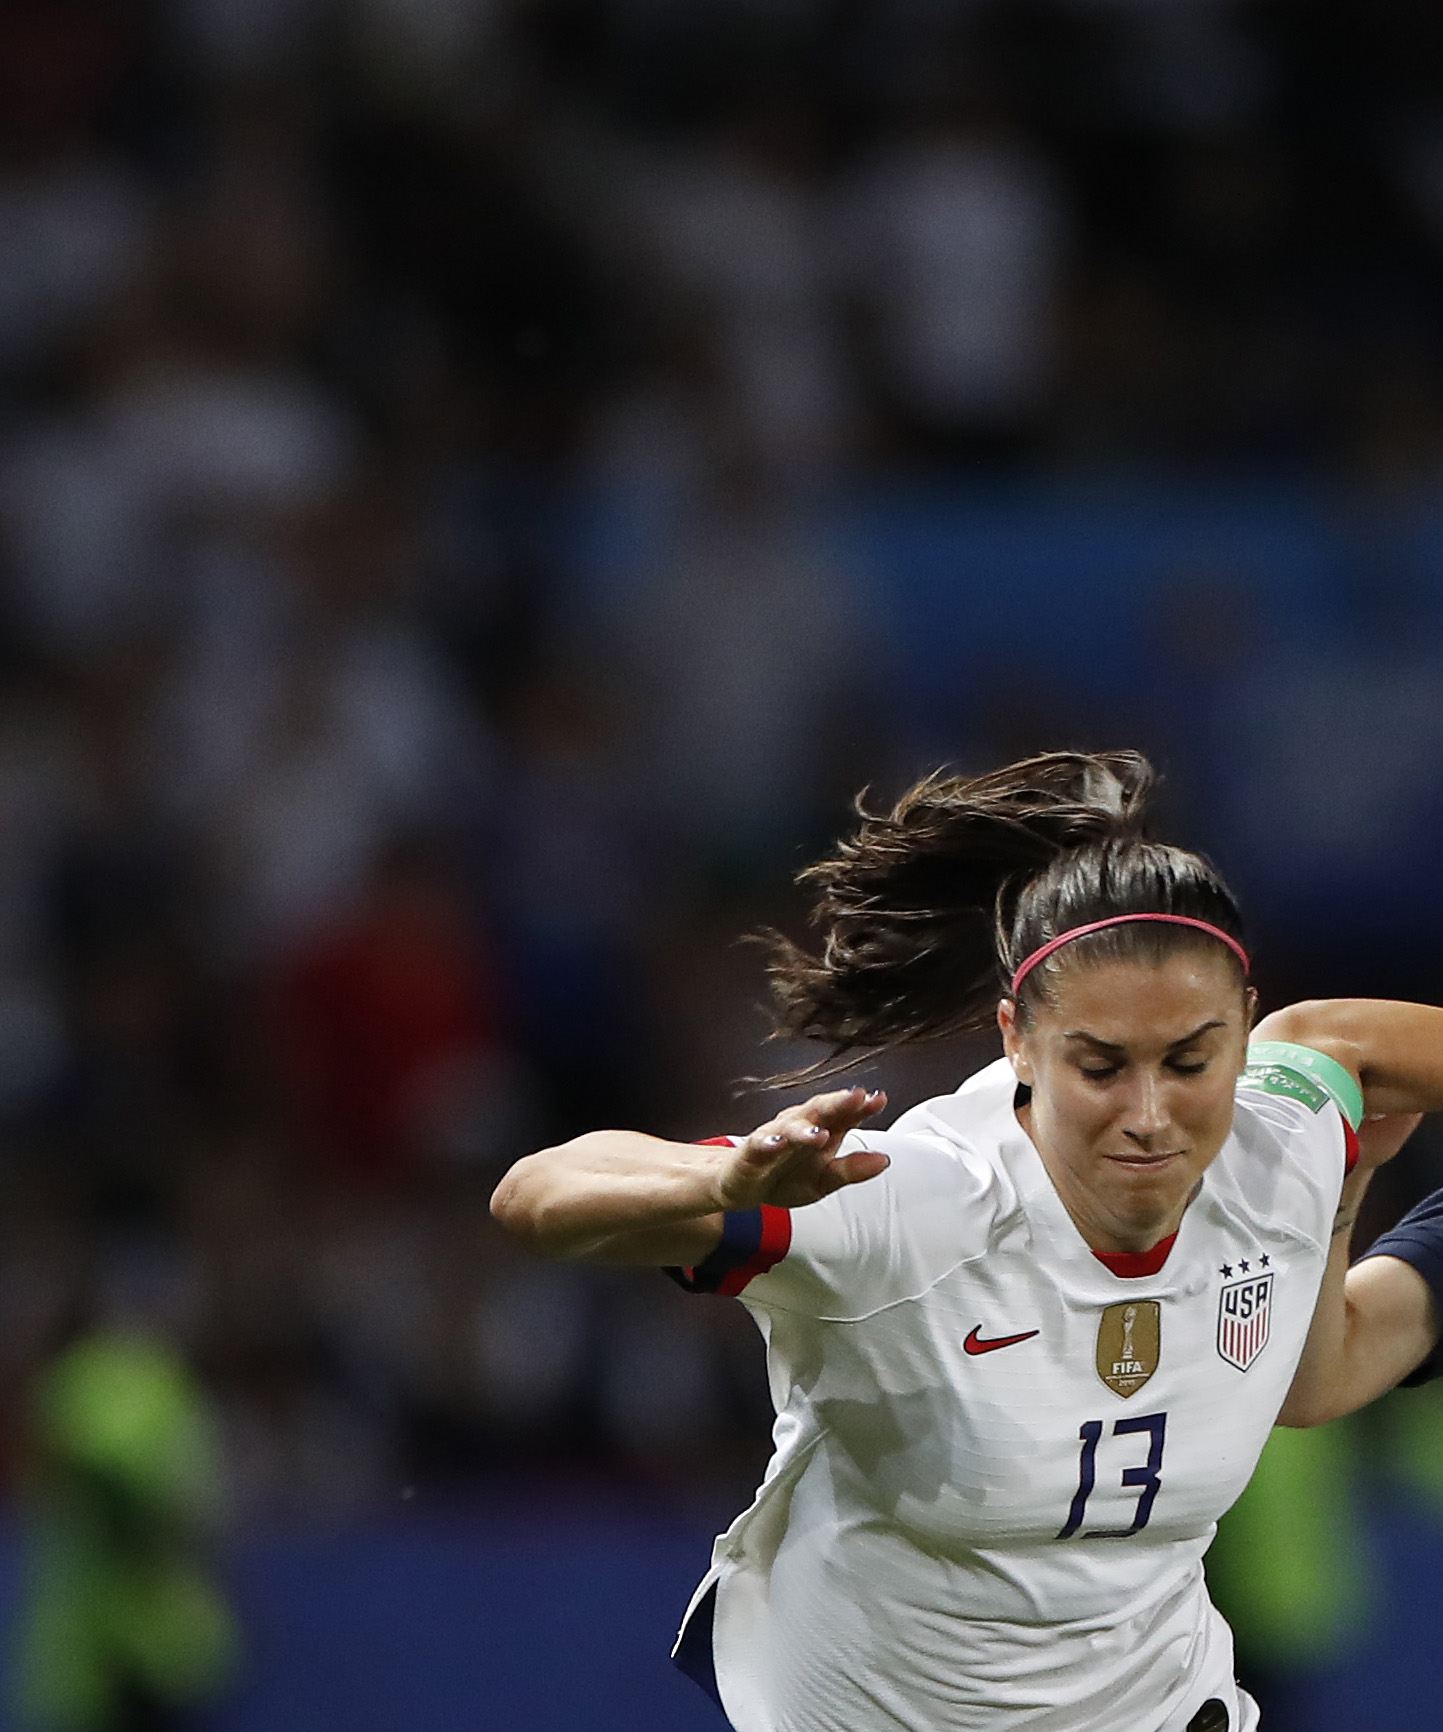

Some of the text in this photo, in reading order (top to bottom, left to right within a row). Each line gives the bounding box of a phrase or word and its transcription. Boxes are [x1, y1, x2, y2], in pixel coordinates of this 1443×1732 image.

[1225, 1281, 1268, 1319] USA
[1112, 1361, 1143, 1375] FIFA
[1054, 1412, 1168, 1540] 13
